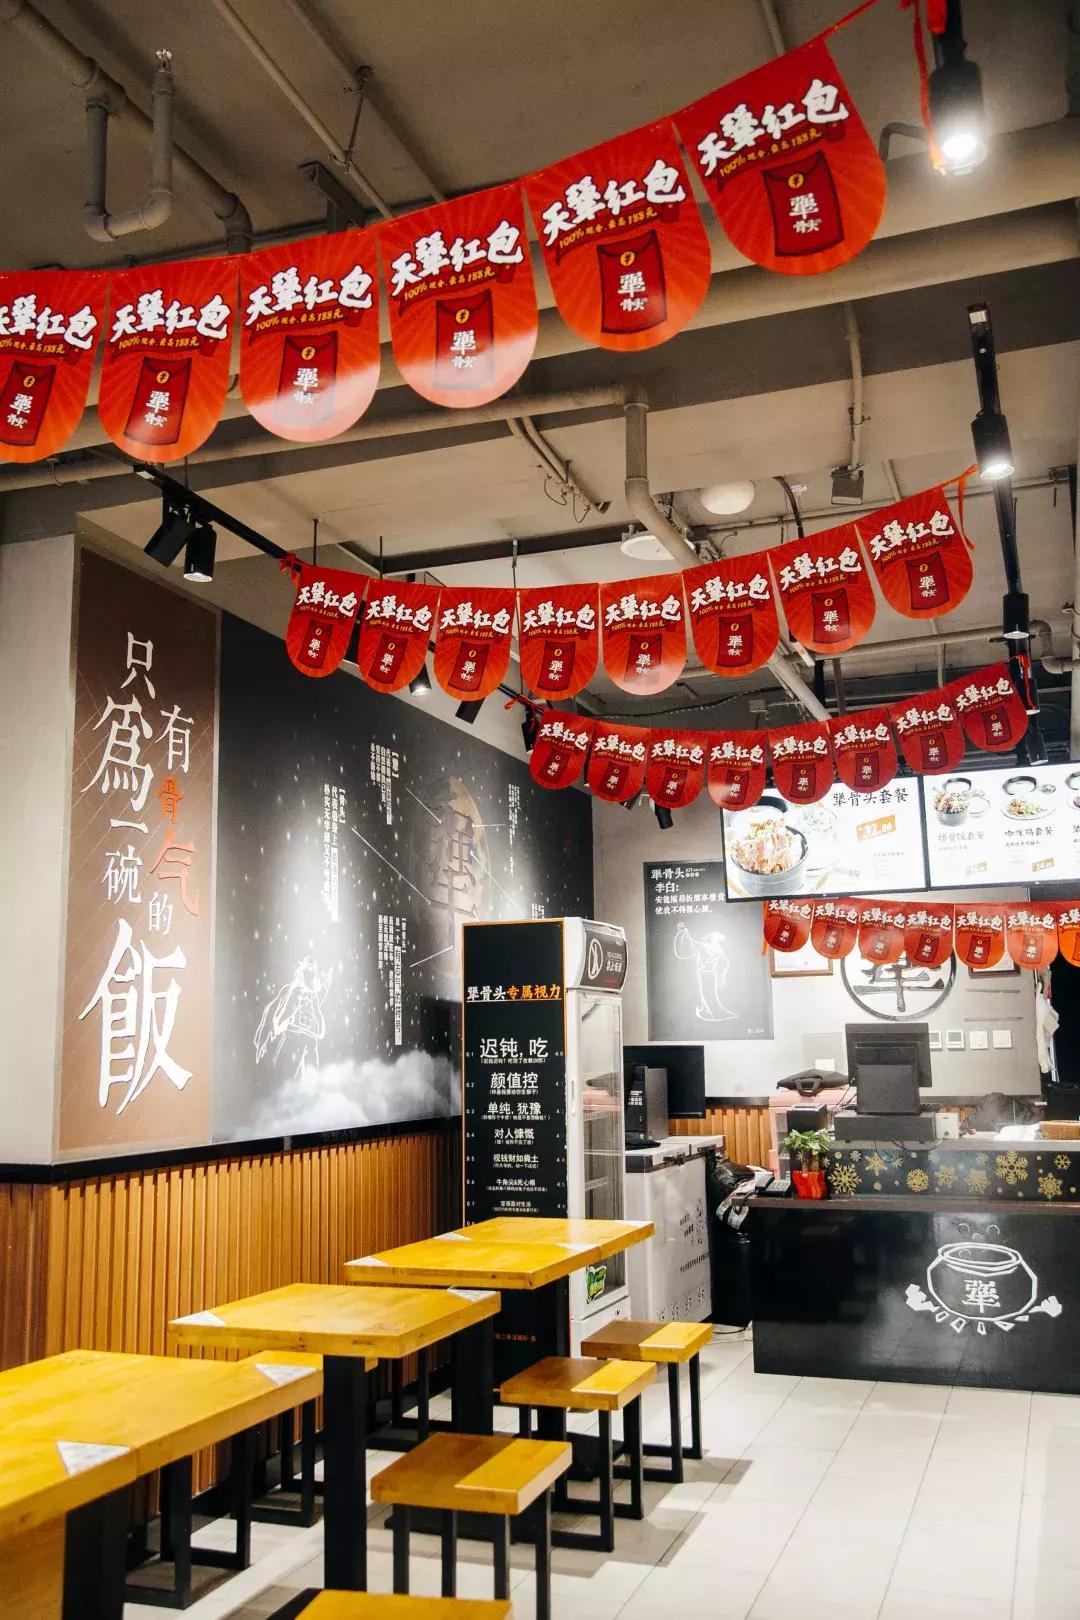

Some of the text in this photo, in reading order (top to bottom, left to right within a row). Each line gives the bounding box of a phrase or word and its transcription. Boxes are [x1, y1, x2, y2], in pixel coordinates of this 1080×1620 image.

[467, 984, 560, 1001] 犟骨头专属视力
[490, 1072, 539, 1089] 颜值控
[494, 1128, 535, 1139] 对人慷慨
[493, 1153, 539, 1163] 视钱财如粪土
